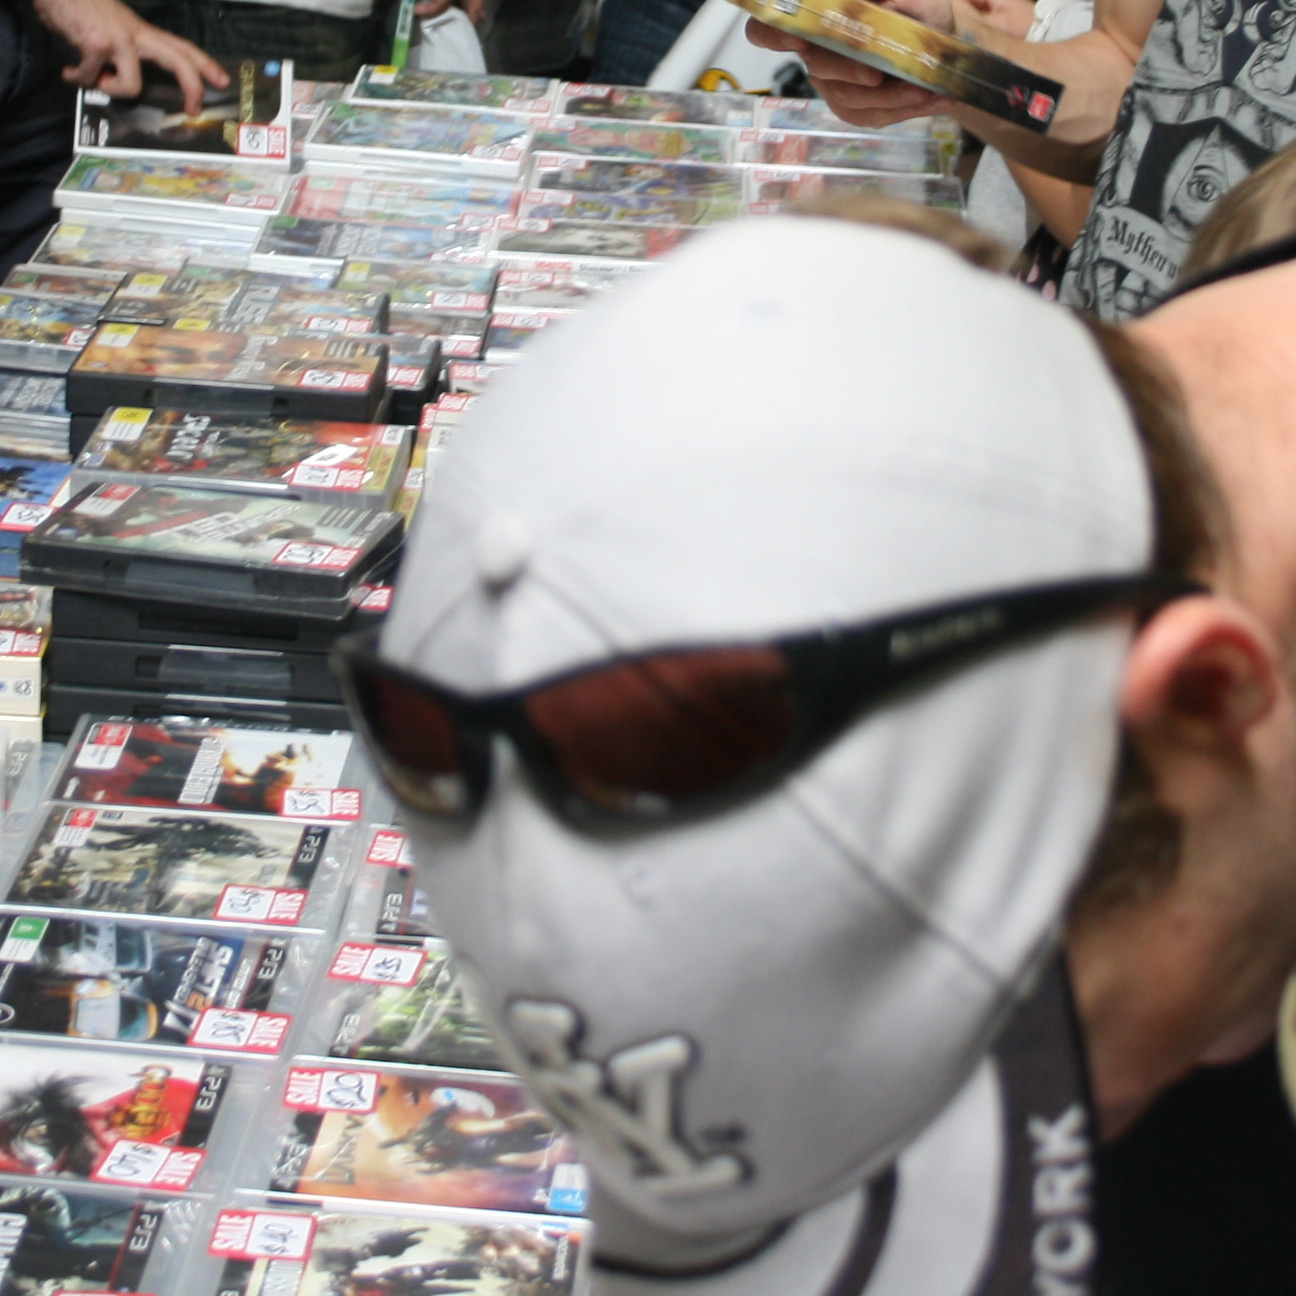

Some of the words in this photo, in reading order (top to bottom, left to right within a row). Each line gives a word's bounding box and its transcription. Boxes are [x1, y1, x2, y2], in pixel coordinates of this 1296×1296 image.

[331, 790, 360, 815] SALE
[299, 834, 321, 864] PS3
[369, 834, 404, 863] SALE
[269, 891, 306, 921] SALE
[383, 891, 404, 922] PS3
[258, 948, 284, 980] PS3
[330, 945, 373, 975] SALE
[248, 1016, 289, 1047] SALE
[194, 1076, 222, 1111] PS3
[284, 1070, 323, 1104] SALE
[326, 1071, 369, 1108] $20
[156, 1151, 203, 1186] SALE
[129, 1212, 158, 1253] PS3
[210, 1214, 255, 1251] SALE
